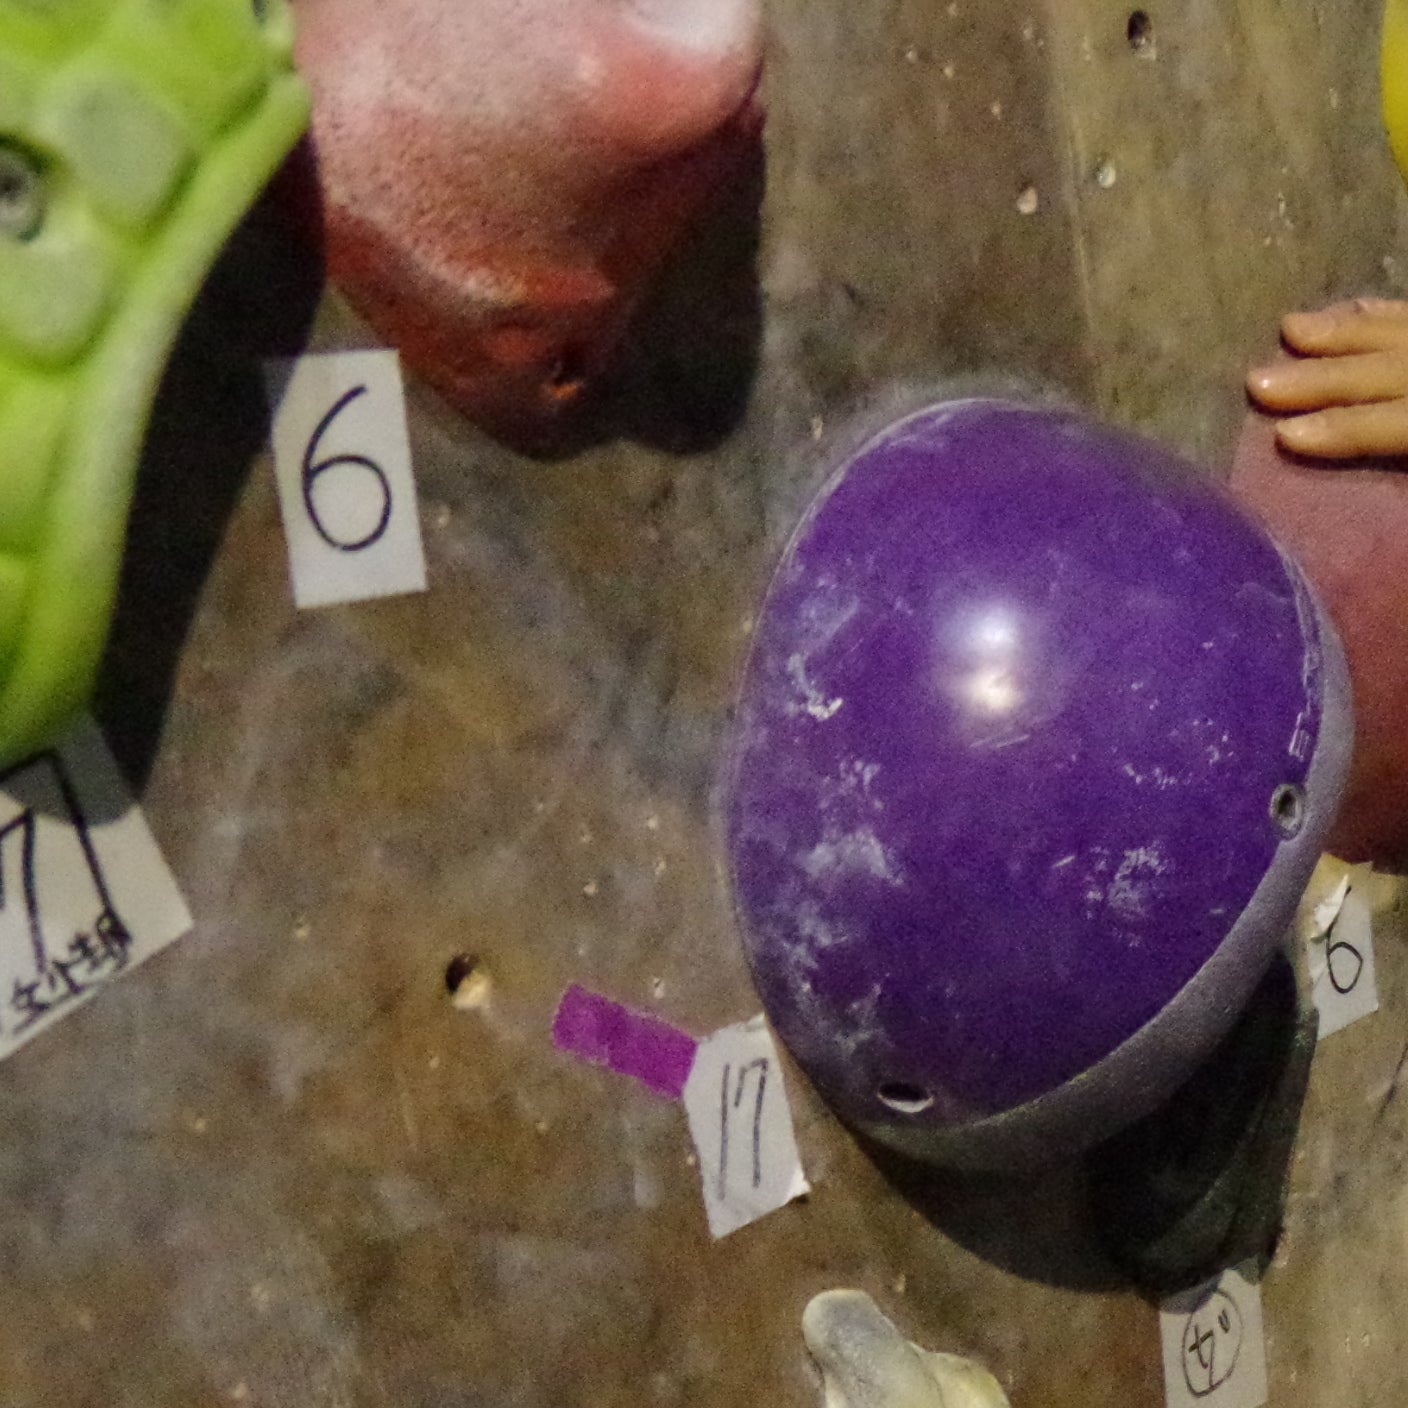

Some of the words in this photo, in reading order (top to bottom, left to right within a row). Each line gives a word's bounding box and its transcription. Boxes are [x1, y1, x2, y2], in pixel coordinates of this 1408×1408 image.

[302, 384, 393, 551] 6
[1326, 885, 1363, 994] 6
[718, 1057, 769, 1200] 17
